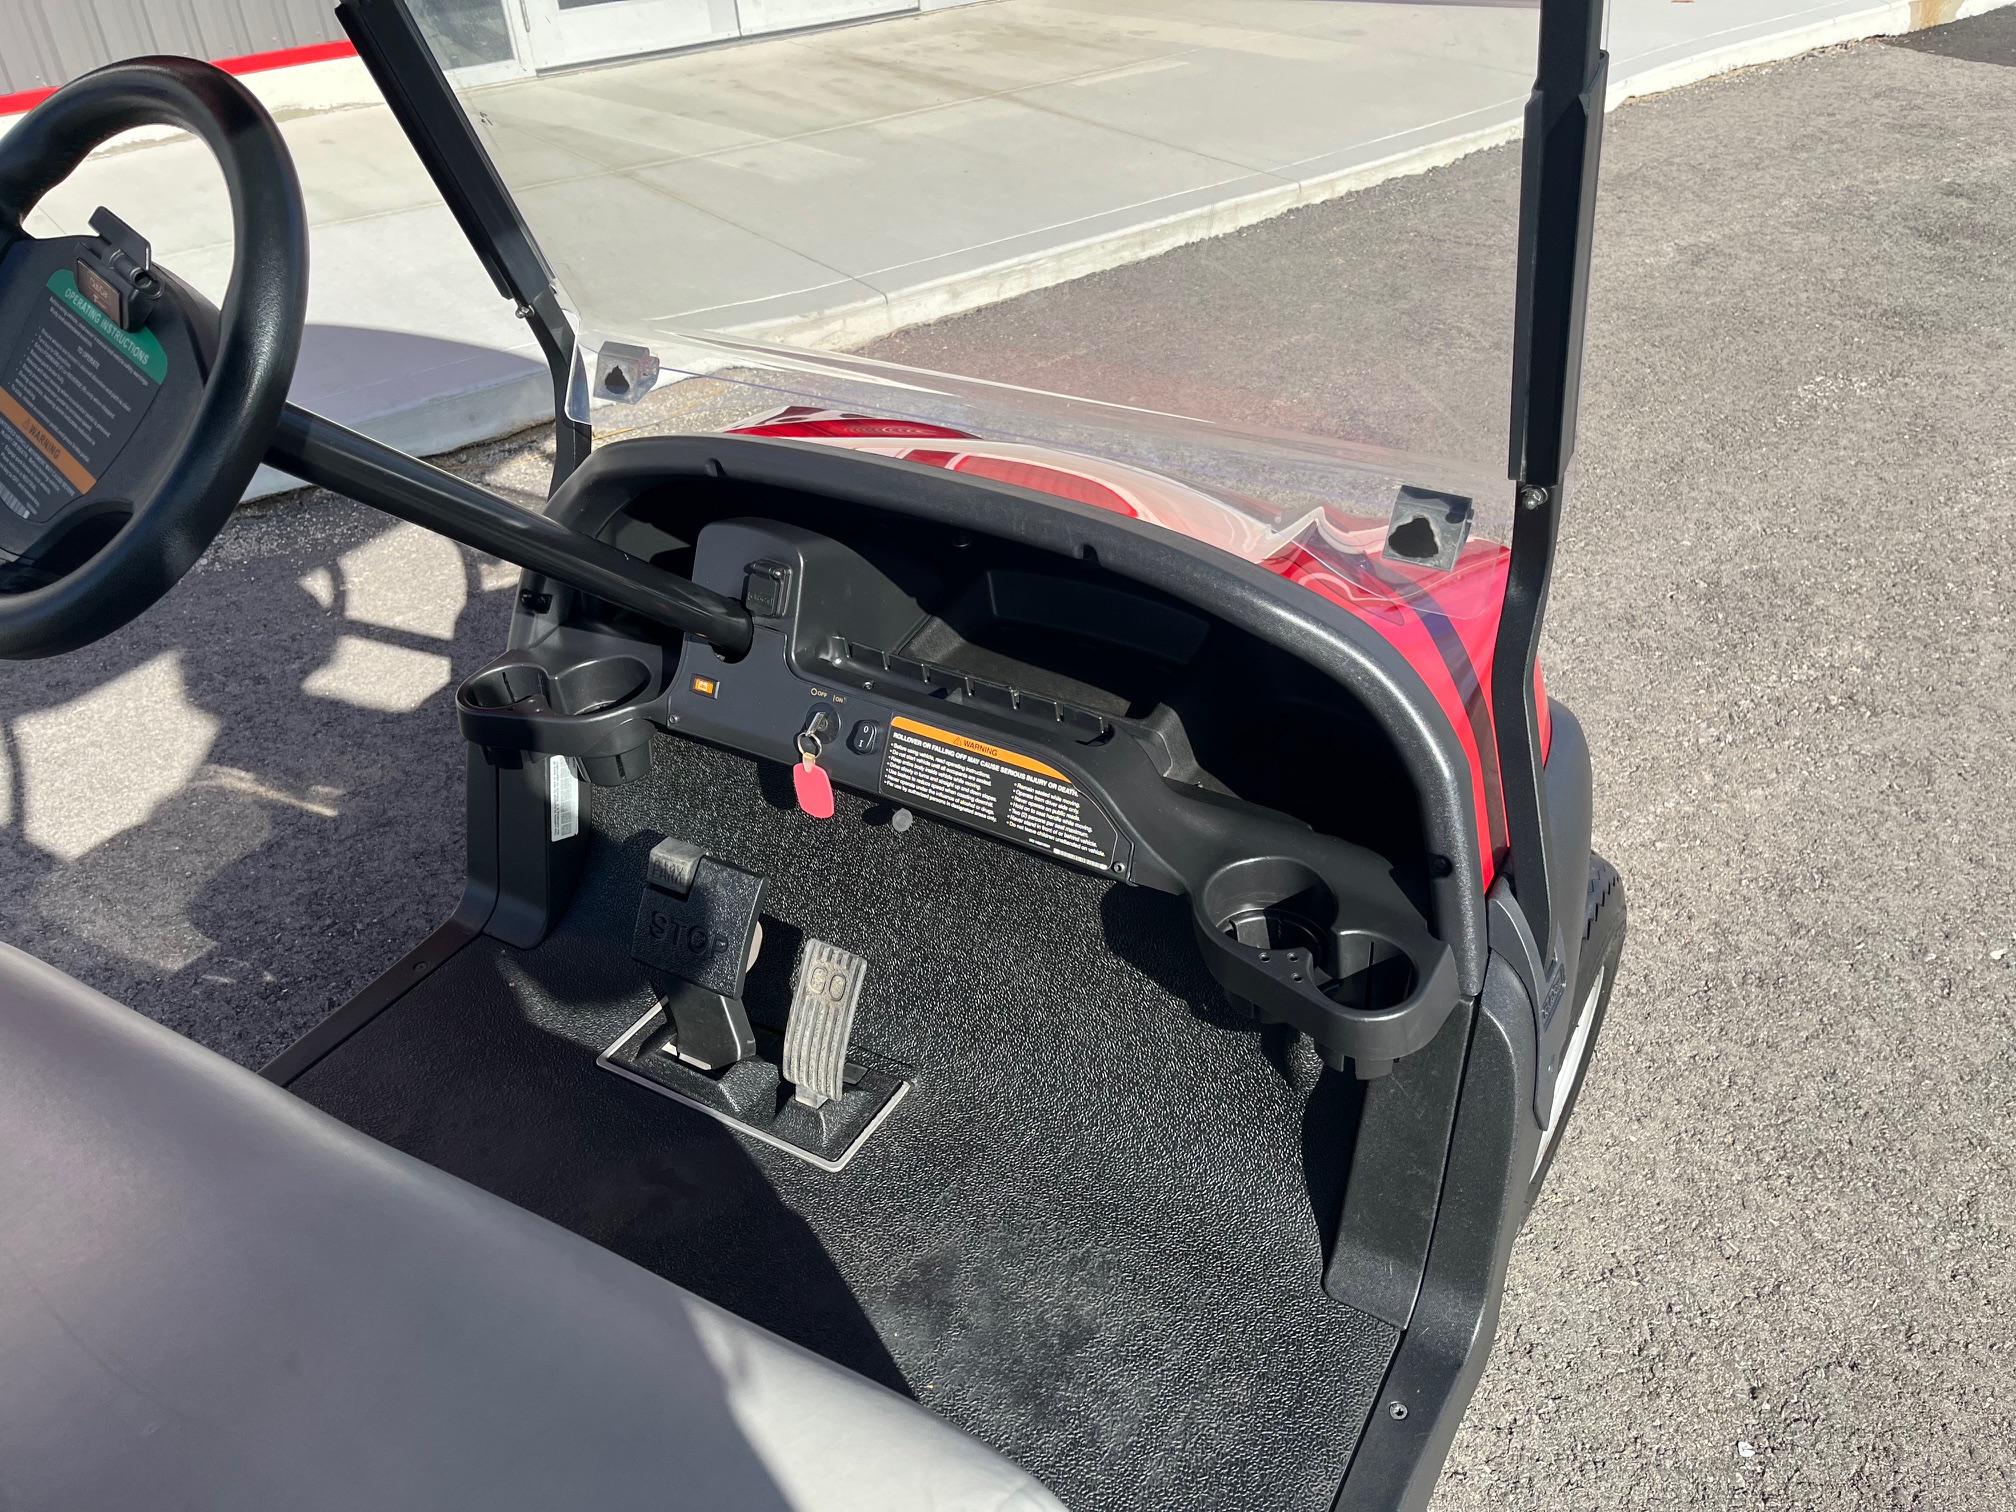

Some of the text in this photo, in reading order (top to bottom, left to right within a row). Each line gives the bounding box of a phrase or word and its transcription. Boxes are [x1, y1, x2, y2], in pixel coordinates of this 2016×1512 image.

[63, 287, 151, 366] OPERATING INSTRUCTIONS
[76, 345, 101, 370] TO OPERATE
[28, 423, 61, 460] WARNING
[893, 732, 1080, 798] ROLLOVER OR FALLING OFF MAY CAUSE SERIOUS INJURY OR DEATH.
[963, 739, 999, 758] WARNING
[651, 859, 685, 885] PARK
[648, 909, 729, 959] STOP
[808, 965, 848, 1002] GO
